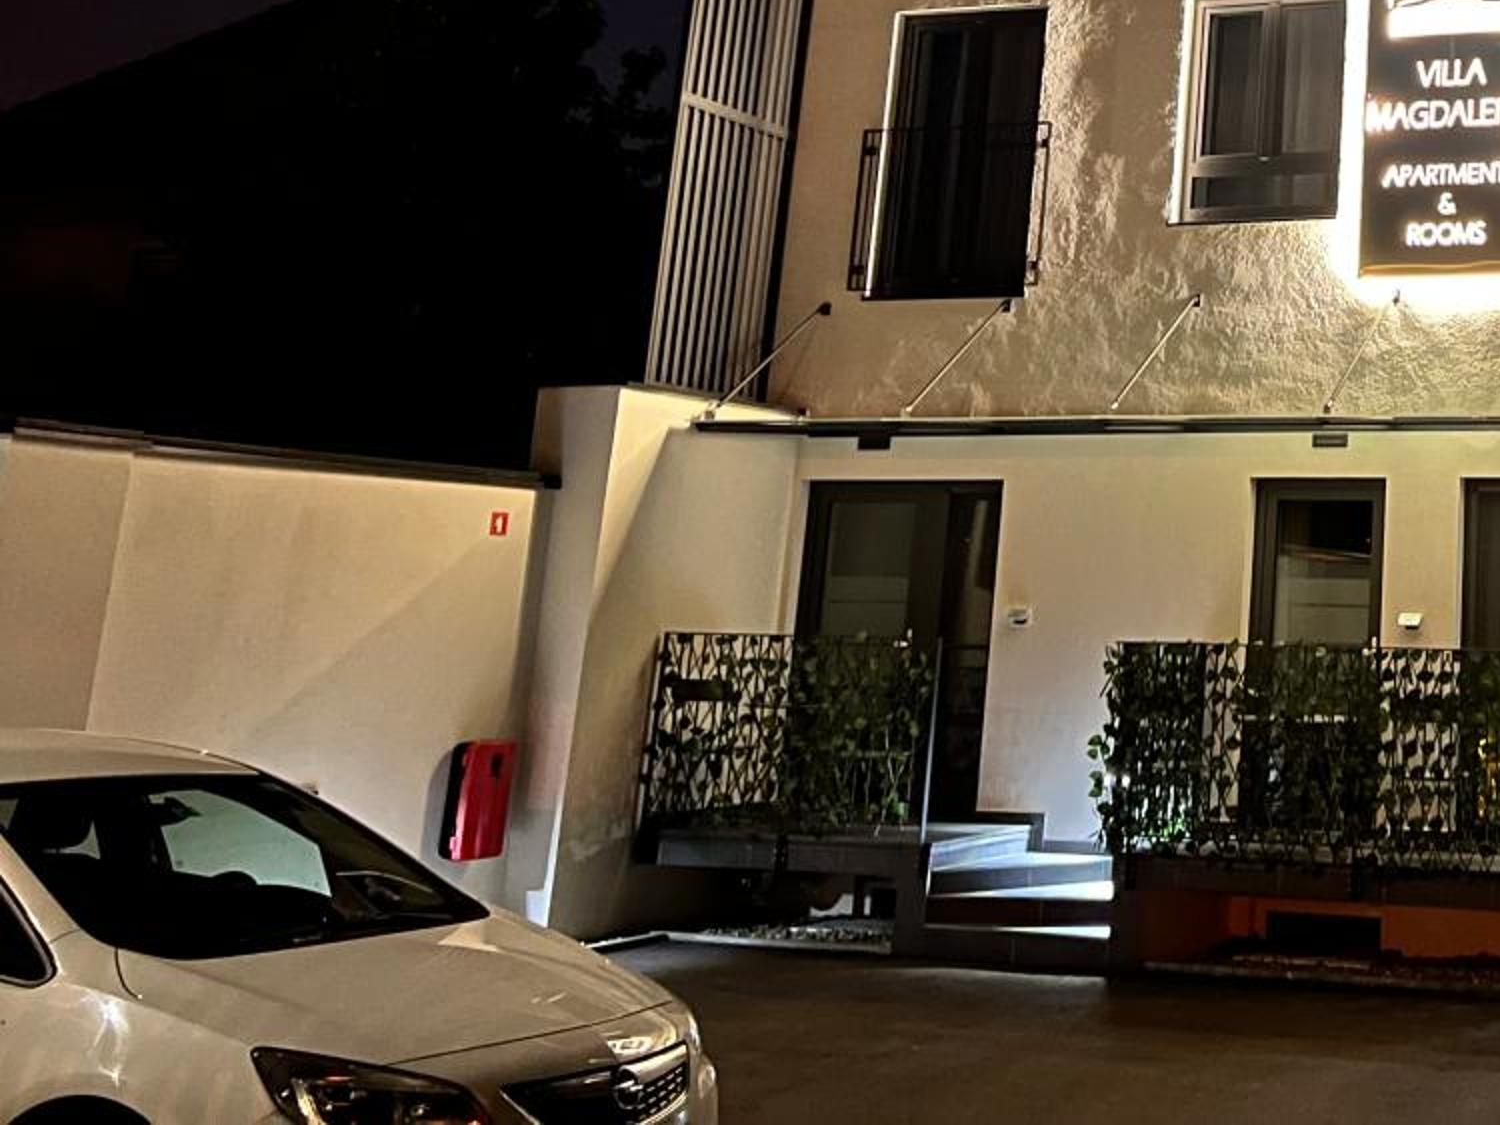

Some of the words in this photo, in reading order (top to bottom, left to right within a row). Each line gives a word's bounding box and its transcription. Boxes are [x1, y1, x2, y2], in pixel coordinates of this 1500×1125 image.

[1416, 58, 1487, 87] VILLA
[1437, 193, 1457, 215] &
[1406, 221, 1486, 246] ROOMS
